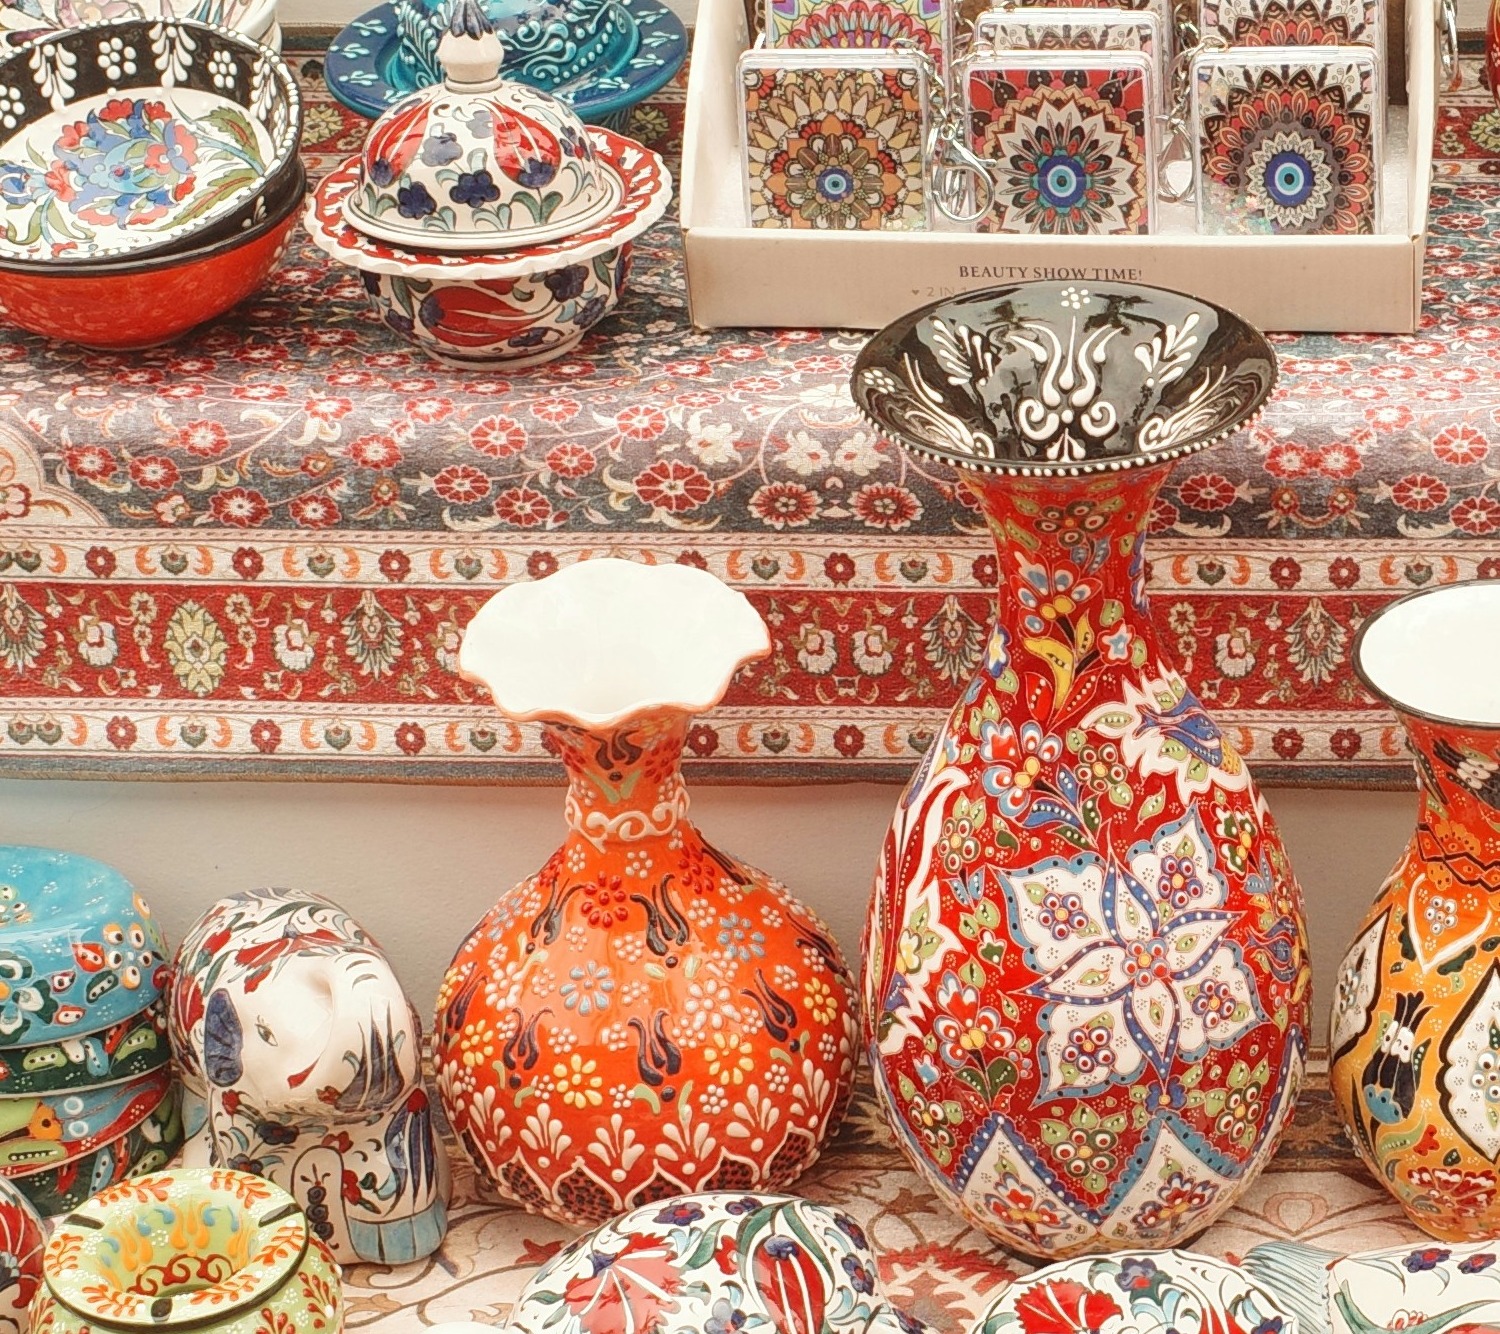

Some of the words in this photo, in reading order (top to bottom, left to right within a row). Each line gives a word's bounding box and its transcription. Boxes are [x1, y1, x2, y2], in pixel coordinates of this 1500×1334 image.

[959, 265, 1029, 279] BEAUTY
[1033, 266, 1087, 280] SHOW
[1091, 266, 1143, 281] TIME!
